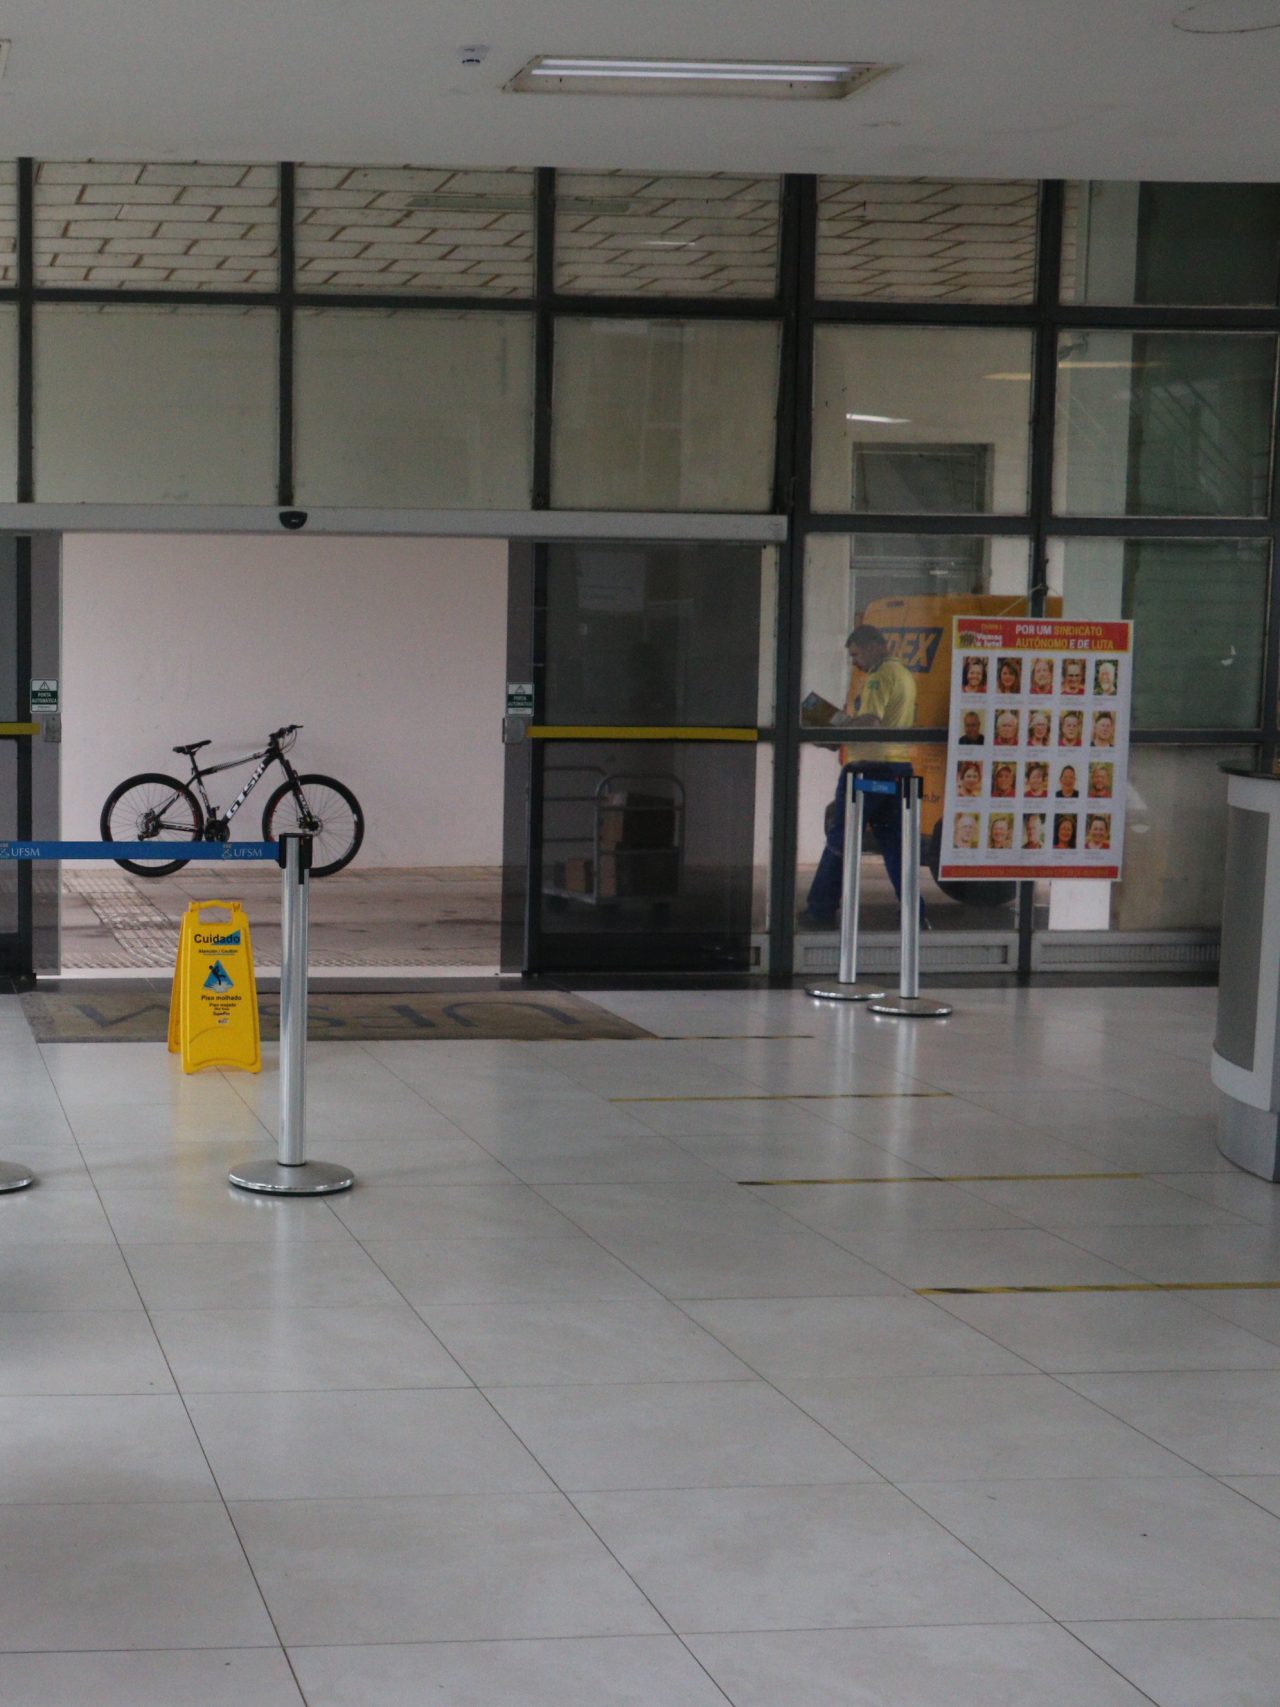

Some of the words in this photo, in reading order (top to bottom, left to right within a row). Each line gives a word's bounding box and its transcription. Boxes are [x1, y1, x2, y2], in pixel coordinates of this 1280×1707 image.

[1016, 624, 1035, 635] POR
[1036, 625, 1052, 635] UM
[1053, 625, 1103, 636] SINDICATO
[1069, 639, 1076, 649] E
[1077, 639, 1090, 649] DE
[1091, 639, 1115, 649] LUTA
[11, 847, 40, 857] UFSM
[233, 848, 263, 857] UFSM
[194, 933, 241, 944] Cuidado
